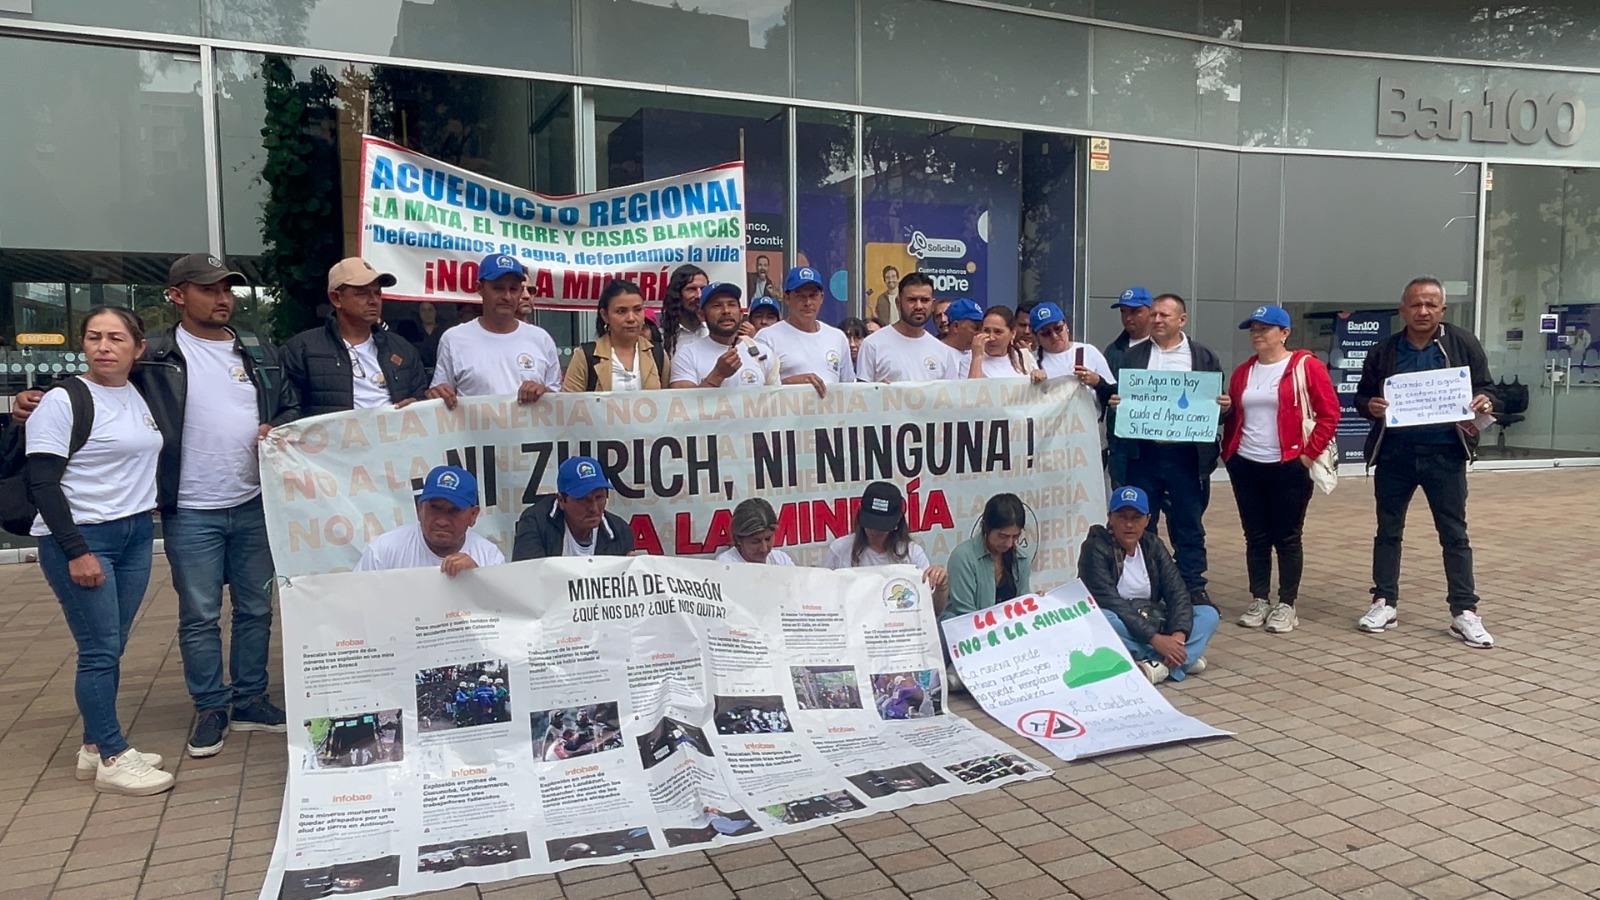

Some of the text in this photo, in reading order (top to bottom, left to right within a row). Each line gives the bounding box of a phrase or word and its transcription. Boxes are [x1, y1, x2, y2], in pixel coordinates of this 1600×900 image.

[1377, 77, 1586, 148] Ban100
[371, 155, 741, 227] ACUEDUCTO REGIONAL
[372, 197, 398, 219] LA
[405, 199, 467, 232] MATA,
[473, 216, 494, 235] EL
[499, 220, 559, 244] TIGRE
[563, 230, 576, 246] Y
[581, 228, 649, 247] CASAS
[653, 217, 740, 242] BLANCAS
[500, 243, 517, 256] el
[521, 247, 570, 265] agua,
[574, 248, 683, 265] defendamos
[687, 245, 701, 262] la
[425, 259, 670, 301] ¡NO A MIRÍ
[1347, 321, 1379, 331] Ban100
[1129, 373, 1200, 393] Sin Agua no hay
[1392, 380, 1423, 390] Cuando
[1425, 379, 1434, 387] el
[340, 417, 370, 450] A
[376, 410, 429, 443] LA
[607, 398, 658, 426] NO
[667, 397, 690, 423] A
[697, 395, 734, 421] LA
[882, 387, 926, 411] NO
[932, 386, 954, 409] A
[962, 385, 993, 409] LA
[1129, 405, 1210, 426] Cuida el Agua como
[1166, 429, 1181, 438] oro
[753, 429, 797, 490] NI
[815, 419, 1011, 484] NINGUNA
[629, 477, 954, 555] A LA MINÍA
[287, 515, 354, 552] NO
[568, 572, 723, 602] MINERÍA DE CARBÓN
[573, 597, 726, 622] ¿QUÉ NOS DA? ¿QUÉ NOS QUITA?
[974, 597, 1039, 629] LA PAZ
[336, 639, 364, 647] infobae
[987, 630, 1001, 647] A
[1004, 622, 1028, 640] LA
[1013, 647, 1040, 670] puede
[451, 767, 488, 777] infobae
[564, 765, 599, 776] infobae
[423, 781, 456, 789] Explosión
[540, 779, 570, 788] Explosión
[332, 793, 372, 803] infobae
[423, 794, 500, 808] trabajadores fallecidos
